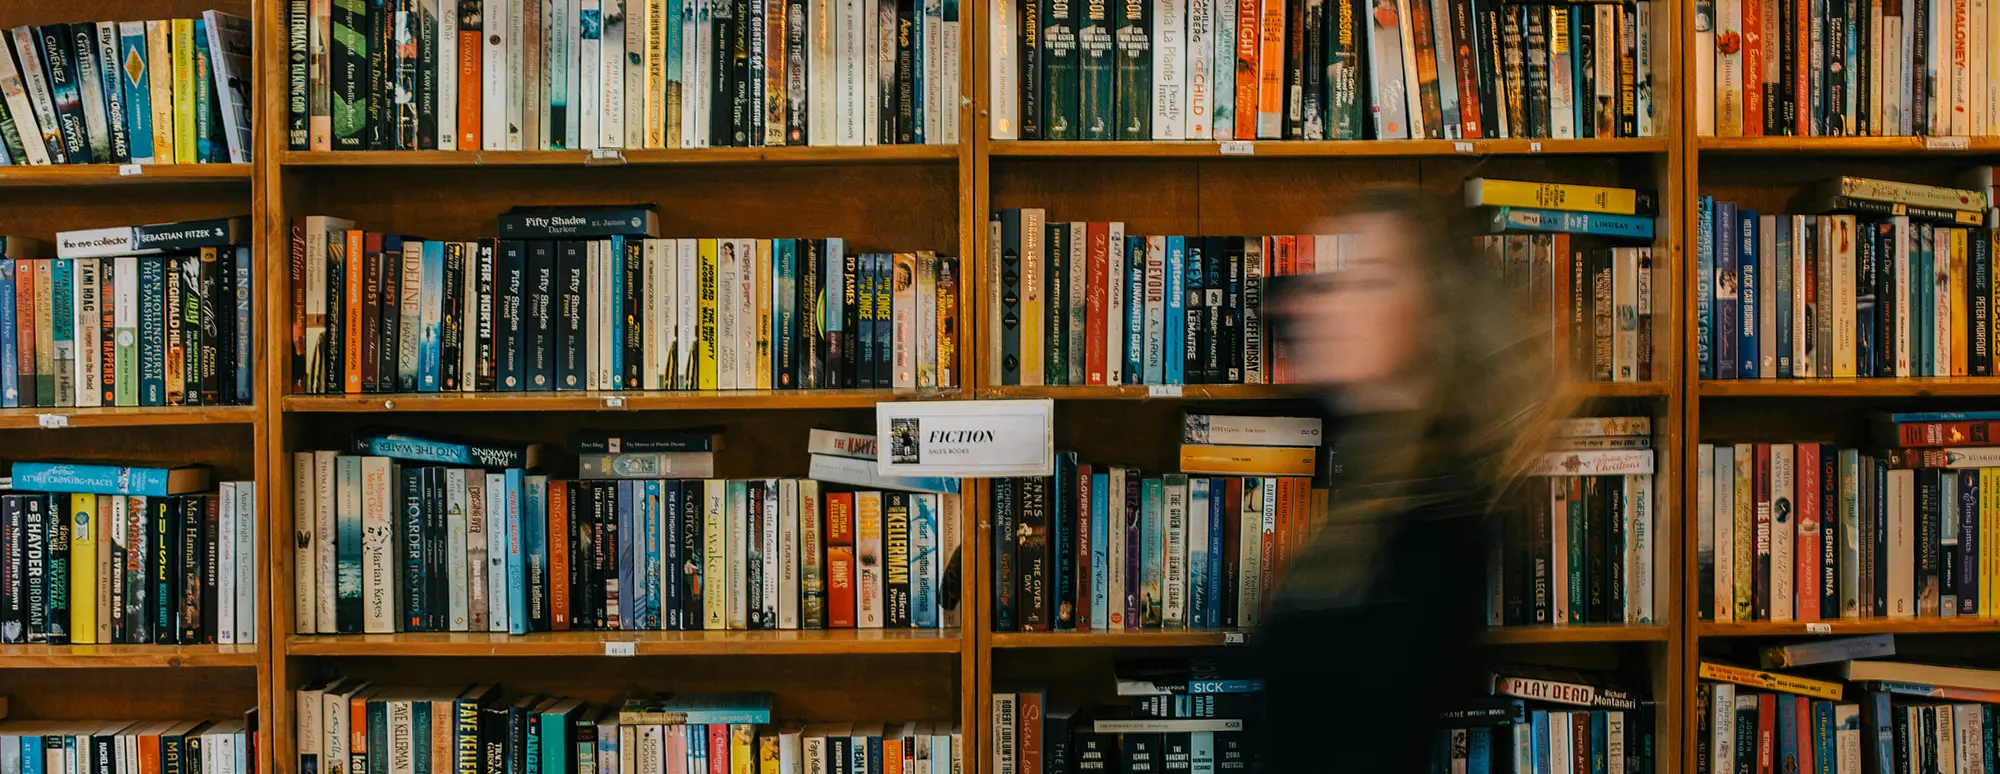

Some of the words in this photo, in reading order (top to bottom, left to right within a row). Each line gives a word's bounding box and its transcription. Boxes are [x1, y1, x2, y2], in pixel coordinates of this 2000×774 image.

[102, 27, 112, 46] Elly
[650, 3, 660, 52] WASHINGTON
[792, 4, 802, 42] BENEATH
[1163, 30, 1176, 42] La
[1241, 18, 1254, 56] LIGHT
[1955, 2, 1966, 68] MALONEY
[46, 36, 64, 83] GIMENEZ
[77, 32, 92, 82] Griffiths
[372, 52, 380, 66] The
[464, 33, 472, 75] HOWARD
[792, 44, 802, 61] THE
[1764, 32, 1774, 60] DAYS
[104, 48, 116, 89] Griffiths
[650, 54, 660, 76] BLACK
[792, 62, 802, 90] ASHES
[1163, 46, 1176, 80] Plante
[1622, 58, 1634, 73] STEP
[372, 70, 380, 90] Dress
[1622, 74, 1634, 84] ON
[370, 93, 380, 120] Lodger
[1158, 84, 1167, 116] Intent
[1167, 84, 1179, 120] Deadly
[1622, 92, 1634, 116] CRACK
[62, 113, 78, 153] LAWYER
[140, 232, 182, 242] SEBASTIAN
[185, 230, 210, 238] FITZEK
[524, 217, 548, 228] Fifty
[552, 216, 586, 226] Shades
[1595, 221, 1628, 230] LINDSAY
[1704, 210, 1712, 258] MICHAEL
[292, 226, 305, 280] Addition
[480, 247, 492, 282] STAR
[144, 262, 152, 280] THE
[152, 262, 161, 290] ALAN
[404, 247, 420, 311] TIDELINE
[510, 270, 520, 294] Fifty
[539, 268, 549, 292] Fifty
[570, 268, 580, 292] Fifty
[1132, 268, 1142, 280] AN
[1148, 260, 1162, 302] DEVOUR
[1170, 250, 1182, 308] sightseeing
[1210, 258, 1219, 286] ALEX
[1744, 264, 1753, 286] BLACK
[168, 272, 180, 328] REGINALD
[859, 291, 872, 320] JONGE
[877, 291, 890, 320] JONGE
[1246, 273, 1259, 309] DEXTER
[1698, 278, 1709, 324] LONELY
[1744, 288, 1753, 304] CAR
[144, 284, 152, 340] SPARSHOLT
[480, 294, 492, 338] NORTH
[510, 296, 520, 332] Shades
[540, 294, 549, 330] Shades
[571, 294, 580, 330] Shades
[1132, 283, 1142, 332] UNWANTED
[1744, 305, 1753, 336] BURNING
[1976, 296, 1986, 318] PETER
[152, 295, 161, 380] HOLLINGHURST
[1246, 316, 1259, 335] JEFF
[1976, 320, 1986, 358] MORFOOT
[170, 330, 180, 352] HILL
[1130, 334, 1141, 362] GUEST
[1246, 336, 1259, 372] LINDSAY
[1698, 327, 1709, 360] DEAD
[144, 344, 152, 380] AFFAIR
[380, 442, 413, 453] WATER
[416, 445, 434, 454] THE
[929, 430, 996, 443] FICTION
[436, 447, 462, 457] INTO
[472, 448, 517, 459] HAWKINS
[480, 456, 508, 466] PAULA
[1596, 459, 1640, 472] Christmas
[409, 476, 417, 493] THE
[1266, 484, 1274, 502] DAVID
[186, 500, 196, 524] Mari
[804, 496, 815, 528] JONATHAN
[1168, 494, 1181, 506] THE
[1266, 504, 1274, 524] LODGE
[1636, 489, 1644, 518] TIGER
[1758, 500, 1770, 522] THE
[408, 496, 420, 558] HOARDER
[685, 502, 694, 550] OUTCAST
[830, 498, 838, 538] KELLERMAN
[858, 496, 880, 540] GONE
[1168, 508, 1181, 528] GIVEN
[12, 528, 20, 556] Should
[128, 498, 144, 570] Atomised
[186, 528, 196, 568] Hannah
[804, 530, 816, 566] KELLERMAN
[888, 513, 908, 584] KELLERMAN
[1168, 532, 1181, 544] DAY
[1632, 522, 1644, 552] HILLS
[1758, 524, 1770, 556] VOGUE
[1826, 528, 1834, 564] DENISE
[28, 524, 42, 576] HAYDER
[708, 533, 722, 572] wake
[917, 546, 930, 575] jonathan
[12, 558, 20, 578] Have
[373, 546, 384, 584] Marian
[510, 564, 520, 590] PUSSY
[530, 554, 542, 584] jonathan
[832, 560, 848, 588] BONES
[1168, 556, 1181, 581] DENNIS
[1536, 558, 1545, 578] ANN
[12, 580, 20, 610] Known
[918, 578, 930, 612] kellerman
[1168, 584, 1181, 608] LEHANE
[1536, 579, 1545, 606] LECKIE
[1826, 567, 1834, 596] MINA
[30, 578, 42, 625] BIRDMAN
[372, 588, 384, 618] Keyes
[530, 586, 542, 618] kellerman
[1194, 682, 1224, 692] SICK
[1514, 680, 1548, 697] PLAY
[1552, 685, 1588, 702] DEAD
[1594, 694, 1636, 708] Montanari
[1605, 689, 1626, 698] Richard
[298, 696, 313, 728] Cathy
[326, 703, 340, 734] Cathy
[460, 703, 478, 732] FAYE
[1022, 704, 1038, 748] Susan
[300, 730, 313, 752] Kelly
[1968, 713, 1978, 749] PEACE
[24, 743, 31, 751] AT
[100, 742, 108, 765] RACHEL
[325, 736, 339, 758] Kelly
[810, 740, 820, 758] Faye
